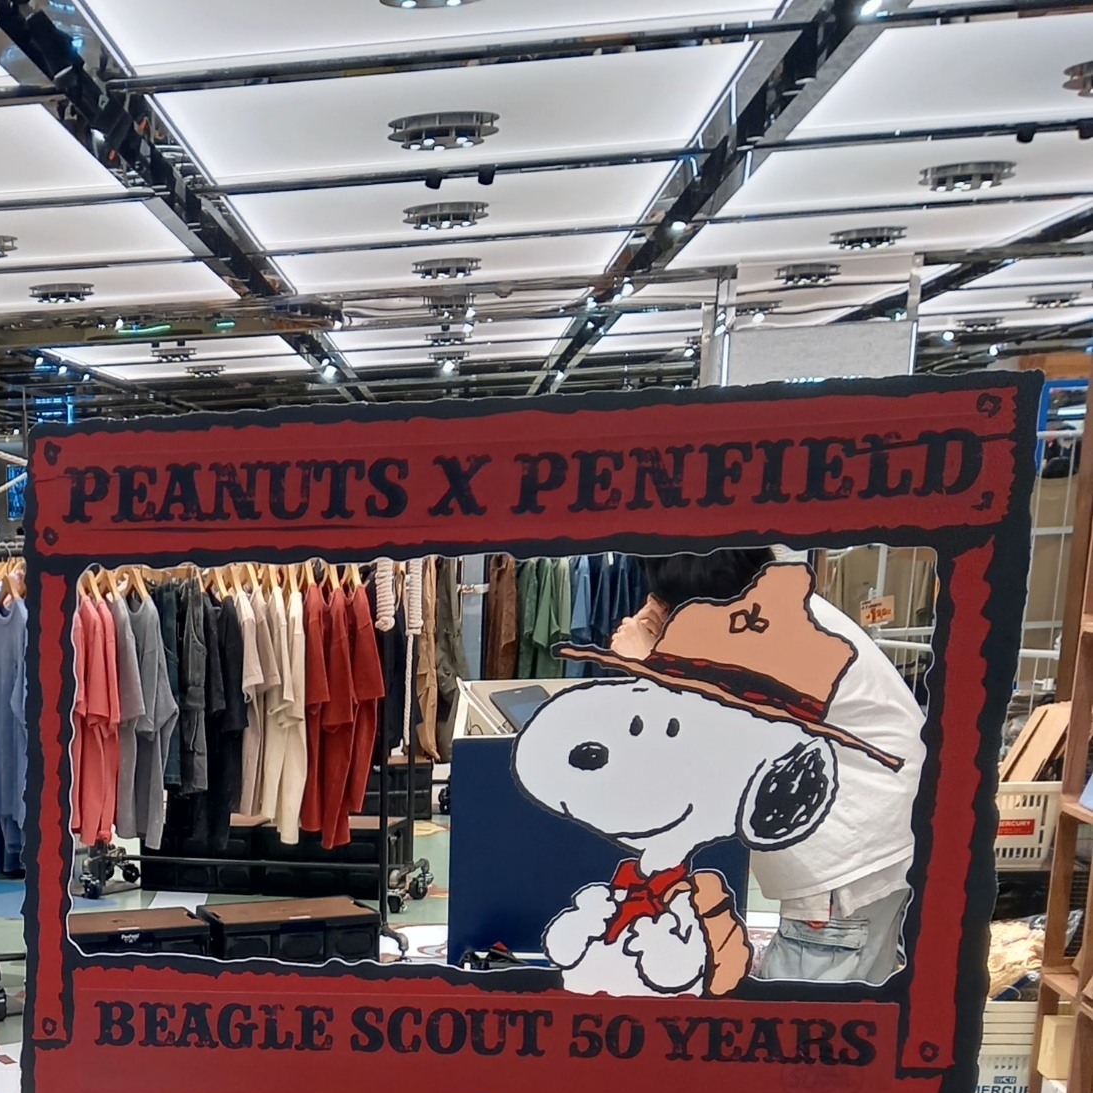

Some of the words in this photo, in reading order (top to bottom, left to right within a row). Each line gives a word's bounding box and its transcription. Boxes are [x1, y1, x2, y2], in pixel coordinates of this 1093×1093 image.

[63, 457, 409, 523] PEANUTS
[428, 454, 493, 517] X
[511, 428, 984, 515] PENFIELD
[94, 1002, 334, 1053] BEAGLE
[350, 1004, 553, 1057] SCOUT
[569, 1012, 647, 1060] 50
[655, 1015, 878, 1068] YEARS
